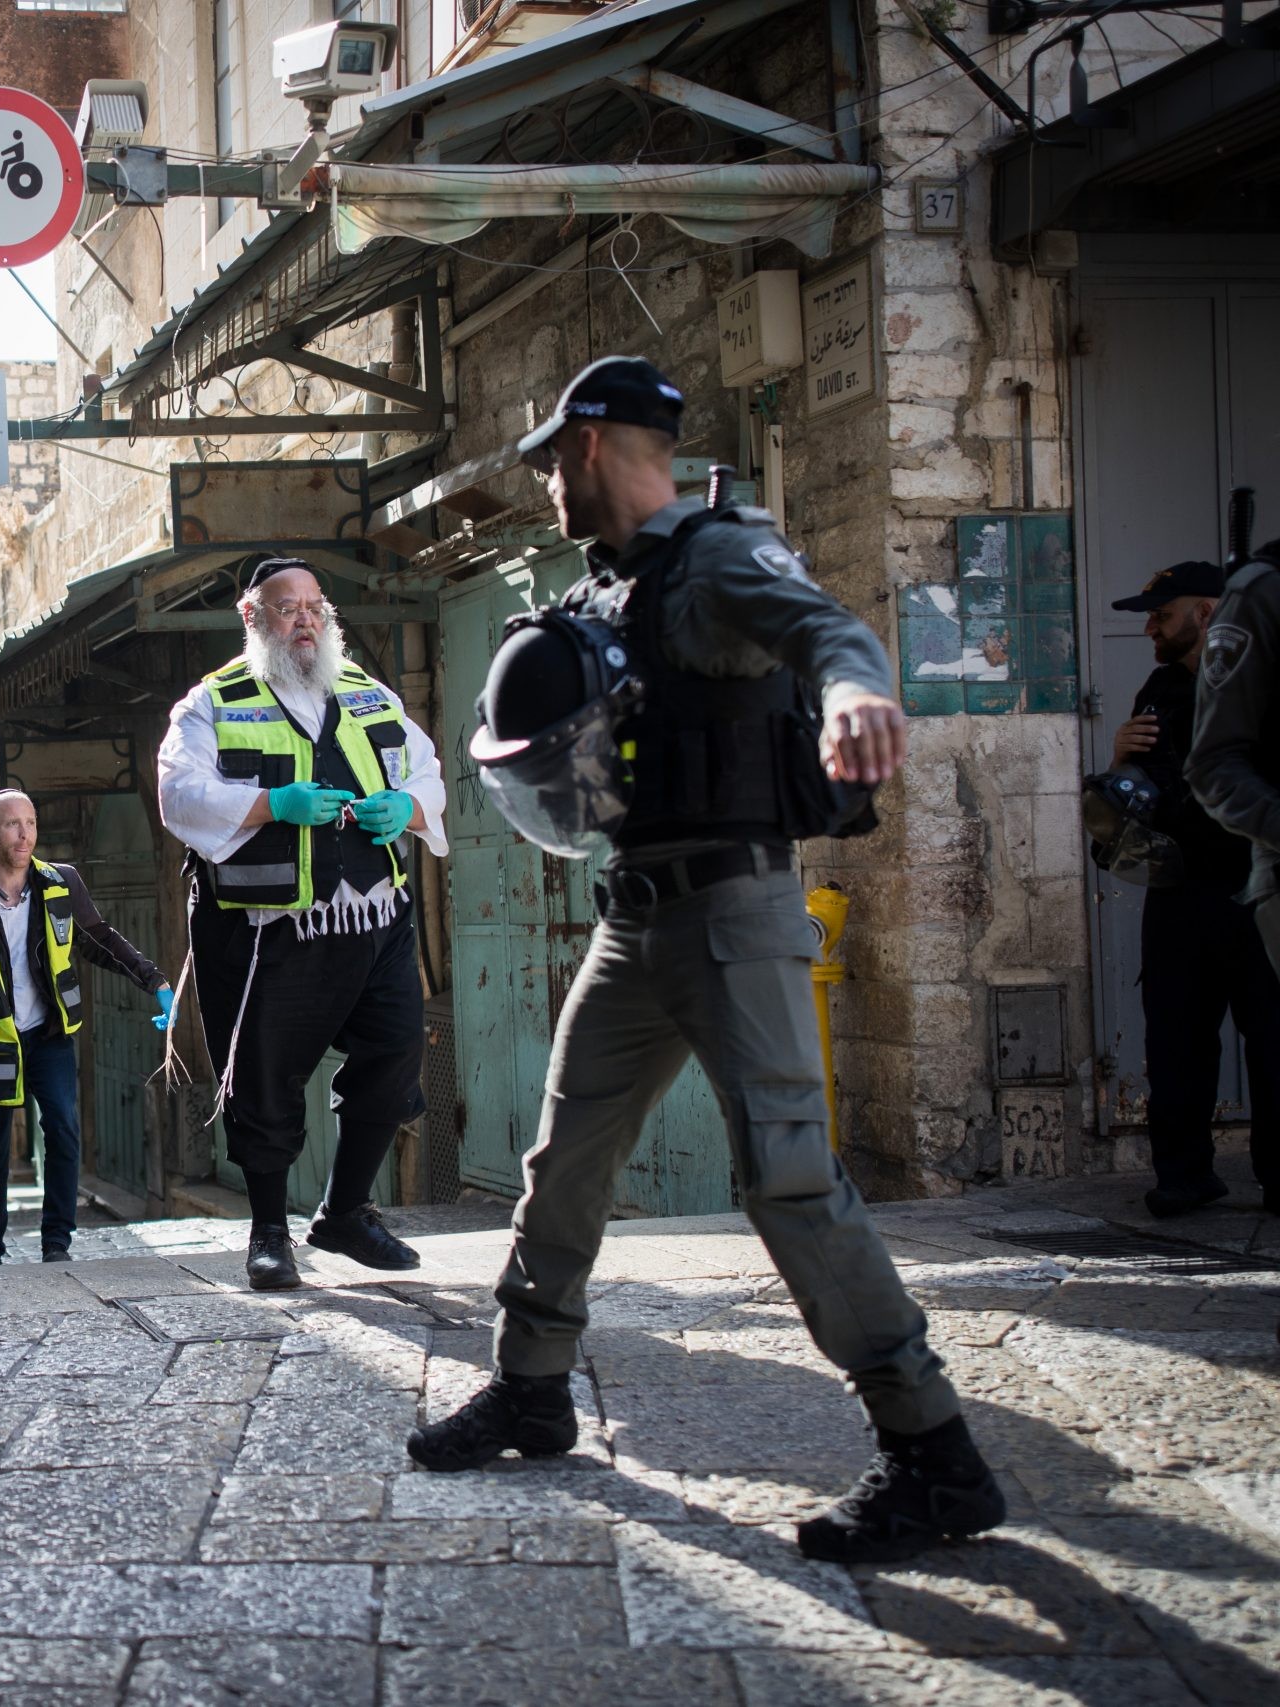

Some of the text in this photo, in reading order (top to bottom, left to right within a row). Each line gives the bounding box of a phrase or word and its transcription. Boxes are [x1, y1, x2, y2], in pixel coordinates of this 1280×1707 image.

[925, 194, 954, 218] 37
[817, 370, 859, 400] DAVID ST.
